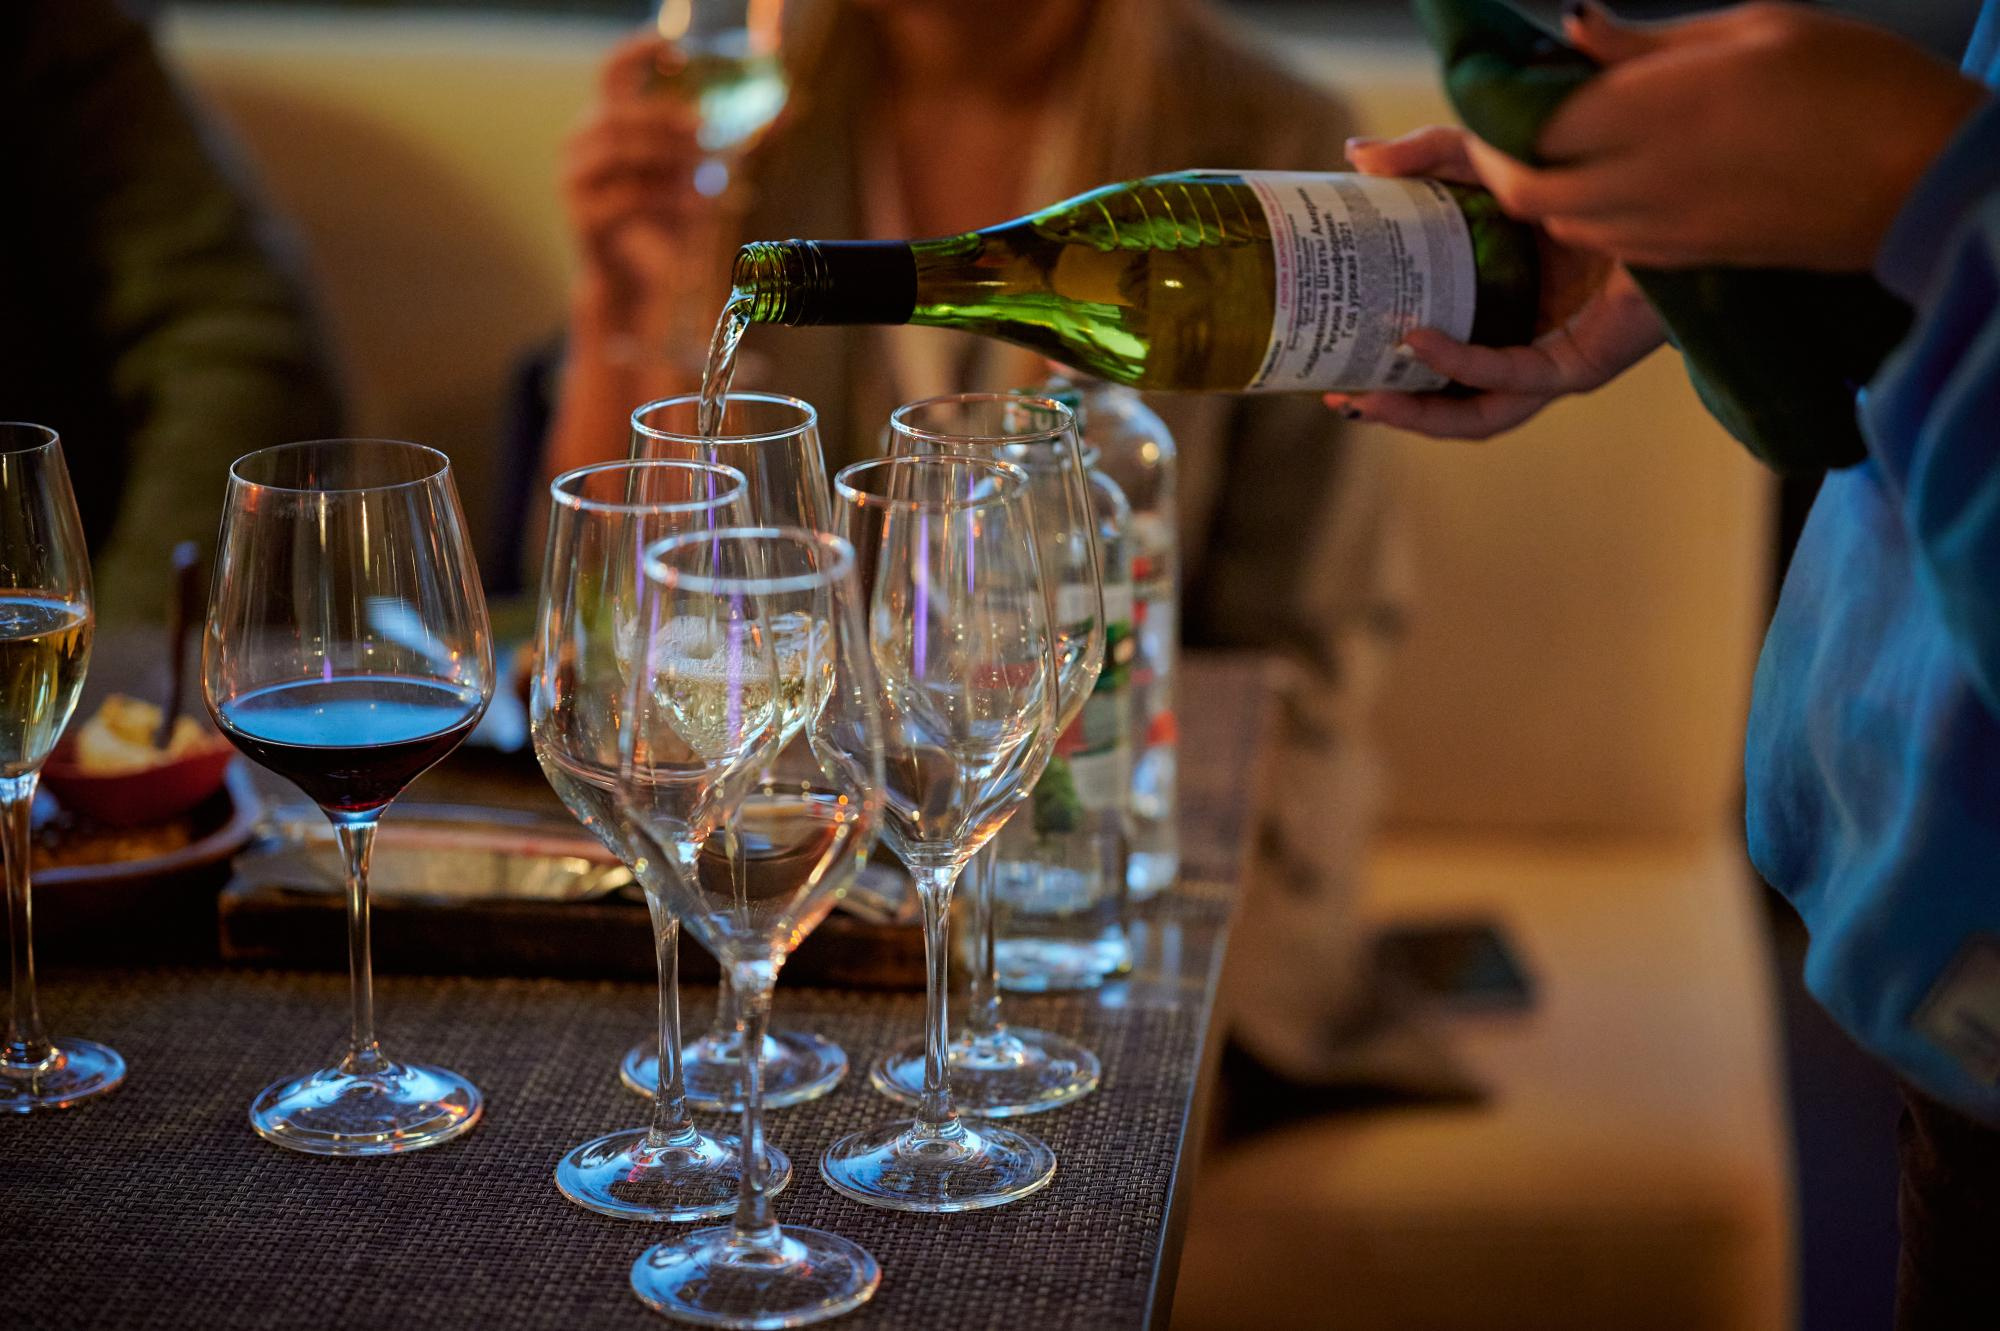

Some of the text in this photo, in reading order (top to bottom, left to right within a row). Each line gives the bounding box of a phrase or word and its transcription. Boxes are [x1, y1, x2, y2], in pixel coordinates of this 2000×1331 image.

[1315, 239, 1330, 289] Штаты
[1338, 221, 1362, 339] Год урожая 2021
